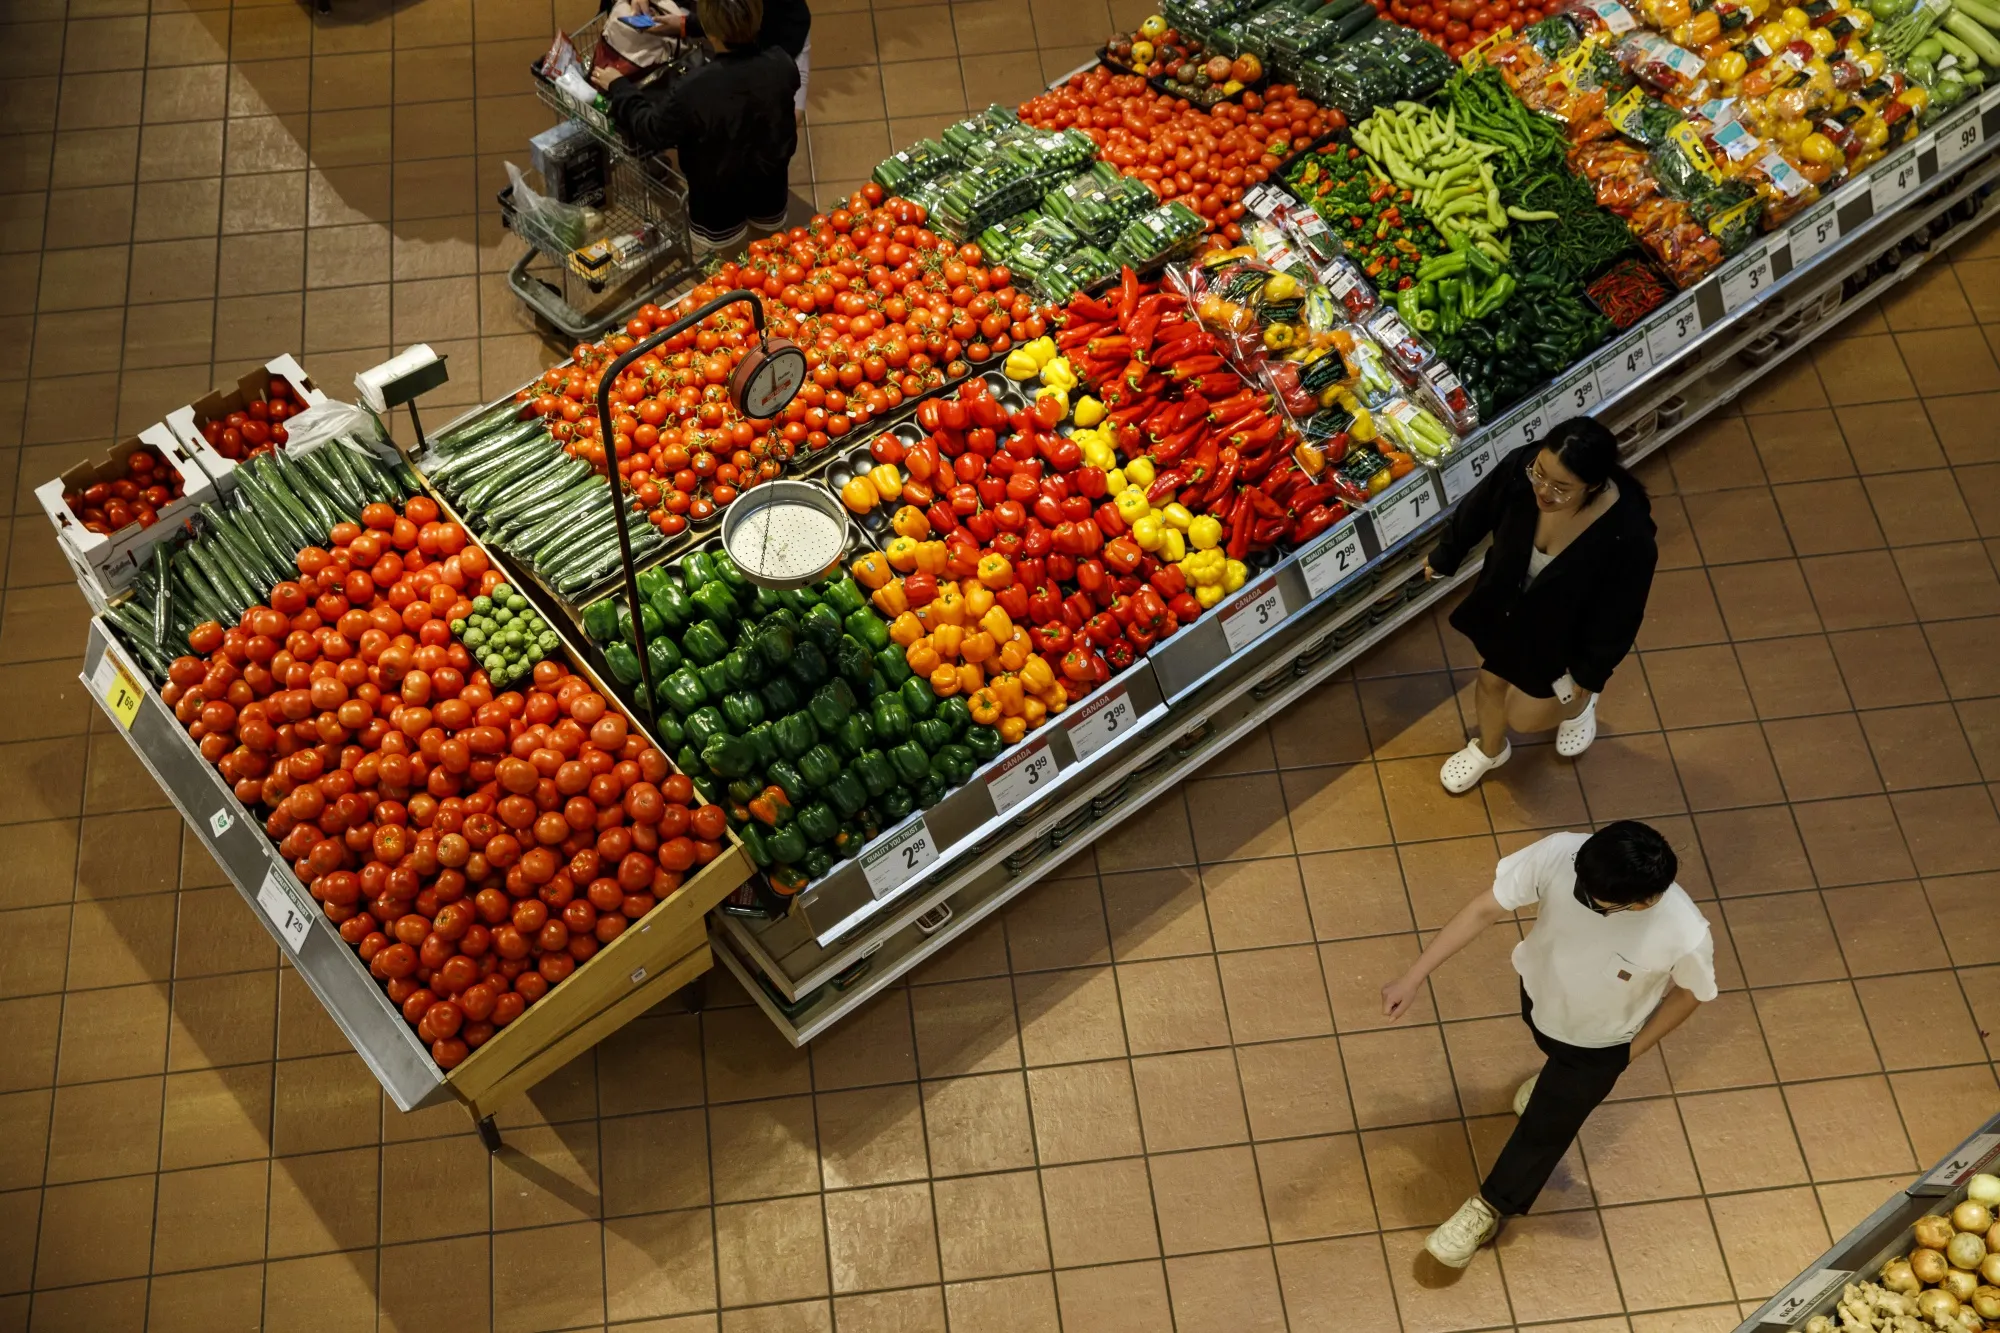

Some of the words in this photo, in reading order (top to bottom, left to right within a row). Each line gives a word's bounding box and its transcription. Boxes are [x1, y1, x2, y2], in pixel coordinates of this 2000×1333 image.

[1381, 493, 1400, 510] QUALITY
[1400, 487, 1410, 496] YOU
[1410, 478, 1424, 490] TRUST
[1306, 546, 1325, 563] QUALITY
[1325, 540, 1335, 549] YOU
[1335, 530, 1350, 543] TRUST
[1235, 589, 1261, 610] CANADA
[1082, 696, 1110, 718] CANADA
[1002, 749, 1031, 771] CANADA
[867, 845, 889, 863] QUALITY
[890, 838, 900, 849] YOU
[901, 826, 918, 840] TRUST
[274, 871, 289, 891] QUALITY
[289, 890, 297, 904] YOU
[295, 901, 309, 917] TRUST
